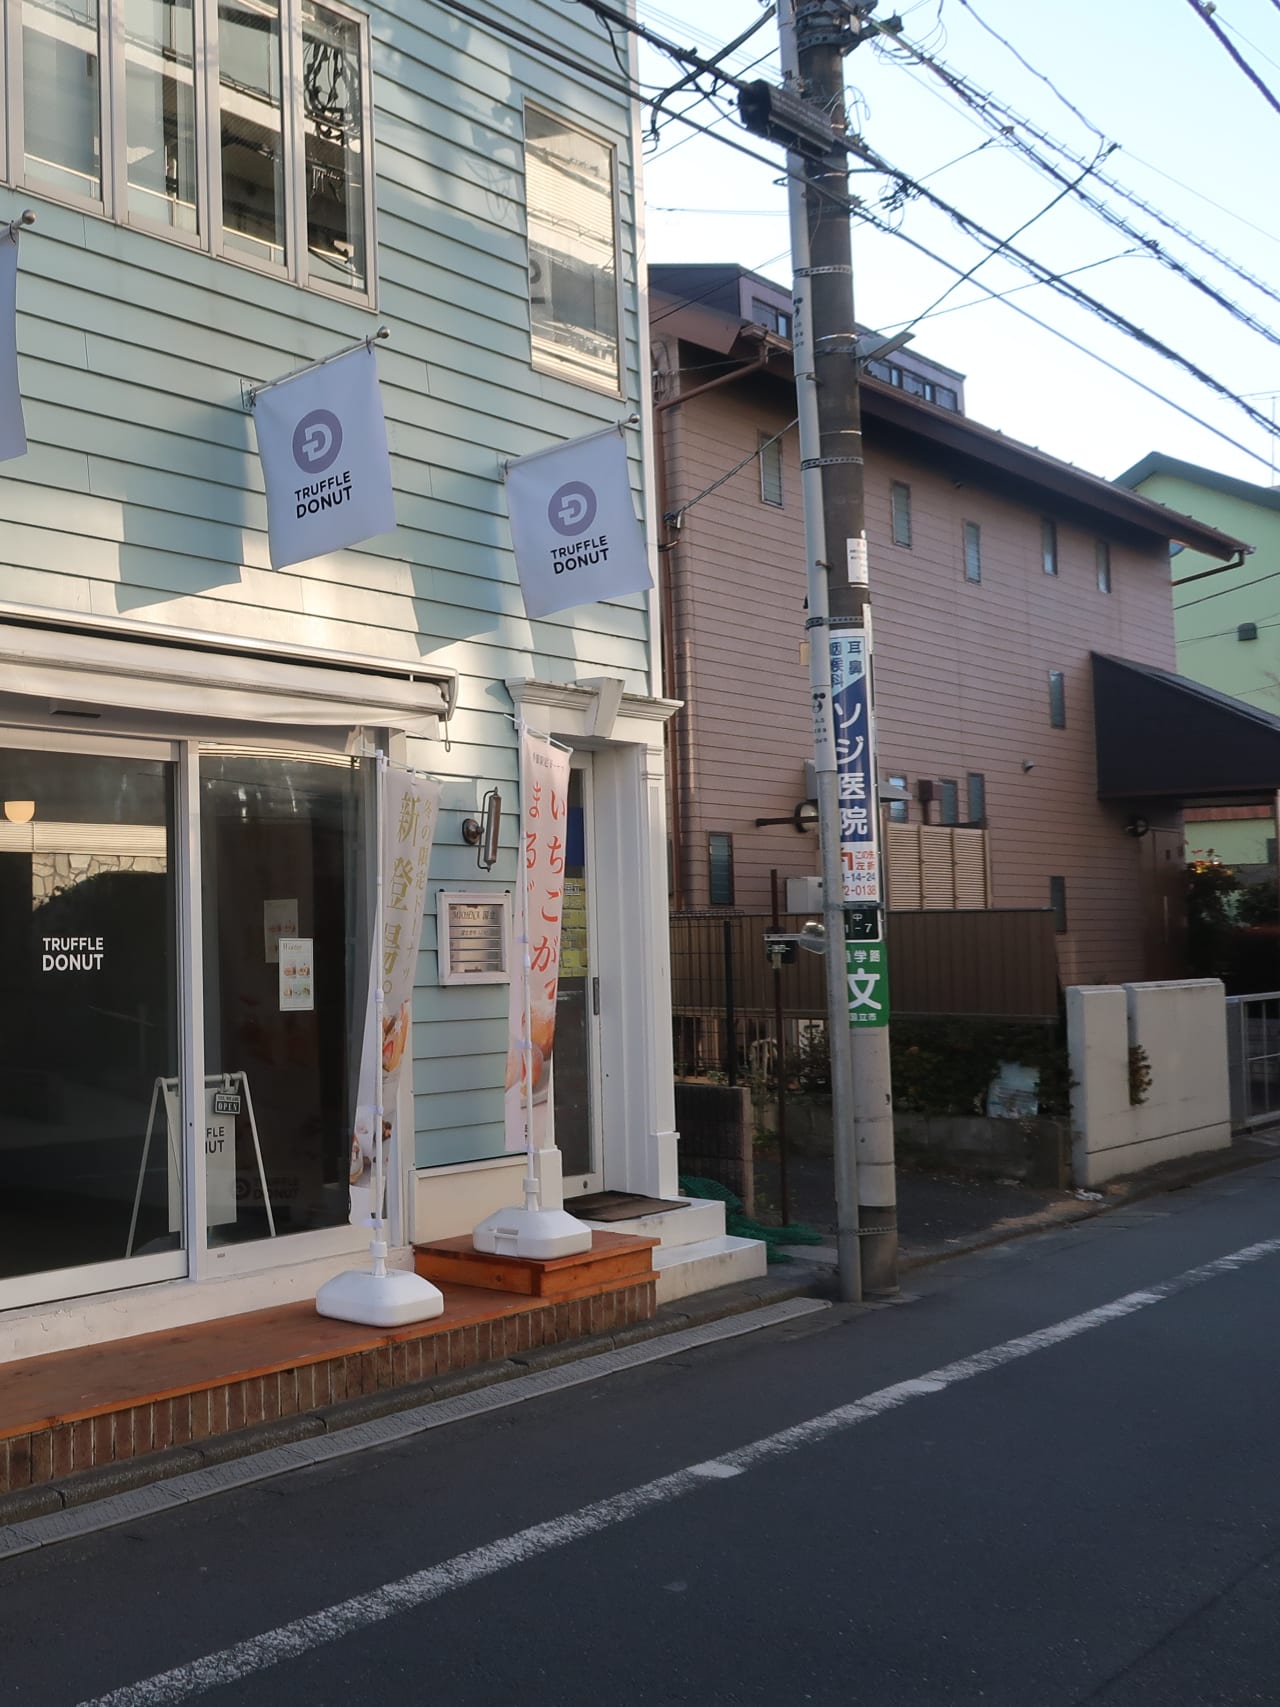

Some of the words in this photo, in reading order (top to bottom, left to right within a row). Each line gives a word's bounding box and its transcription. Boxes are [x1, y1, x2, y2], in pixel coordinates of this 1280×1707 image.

[294, 470, 352, 502] TRUFFLE
[296, 485, 352, 519] DONUT
[550, 535, 608, 560] TRUFFLE
[553, 547, 609, 575] DONUT
[834, 702, 868, 836] ソジ医院
[852, 913, 862, 923] 中
[42, 937, 104, 951] TRUFFLE
[42, 954, 104, 971] DONUT
[848, 967, 882, 1010] 文
